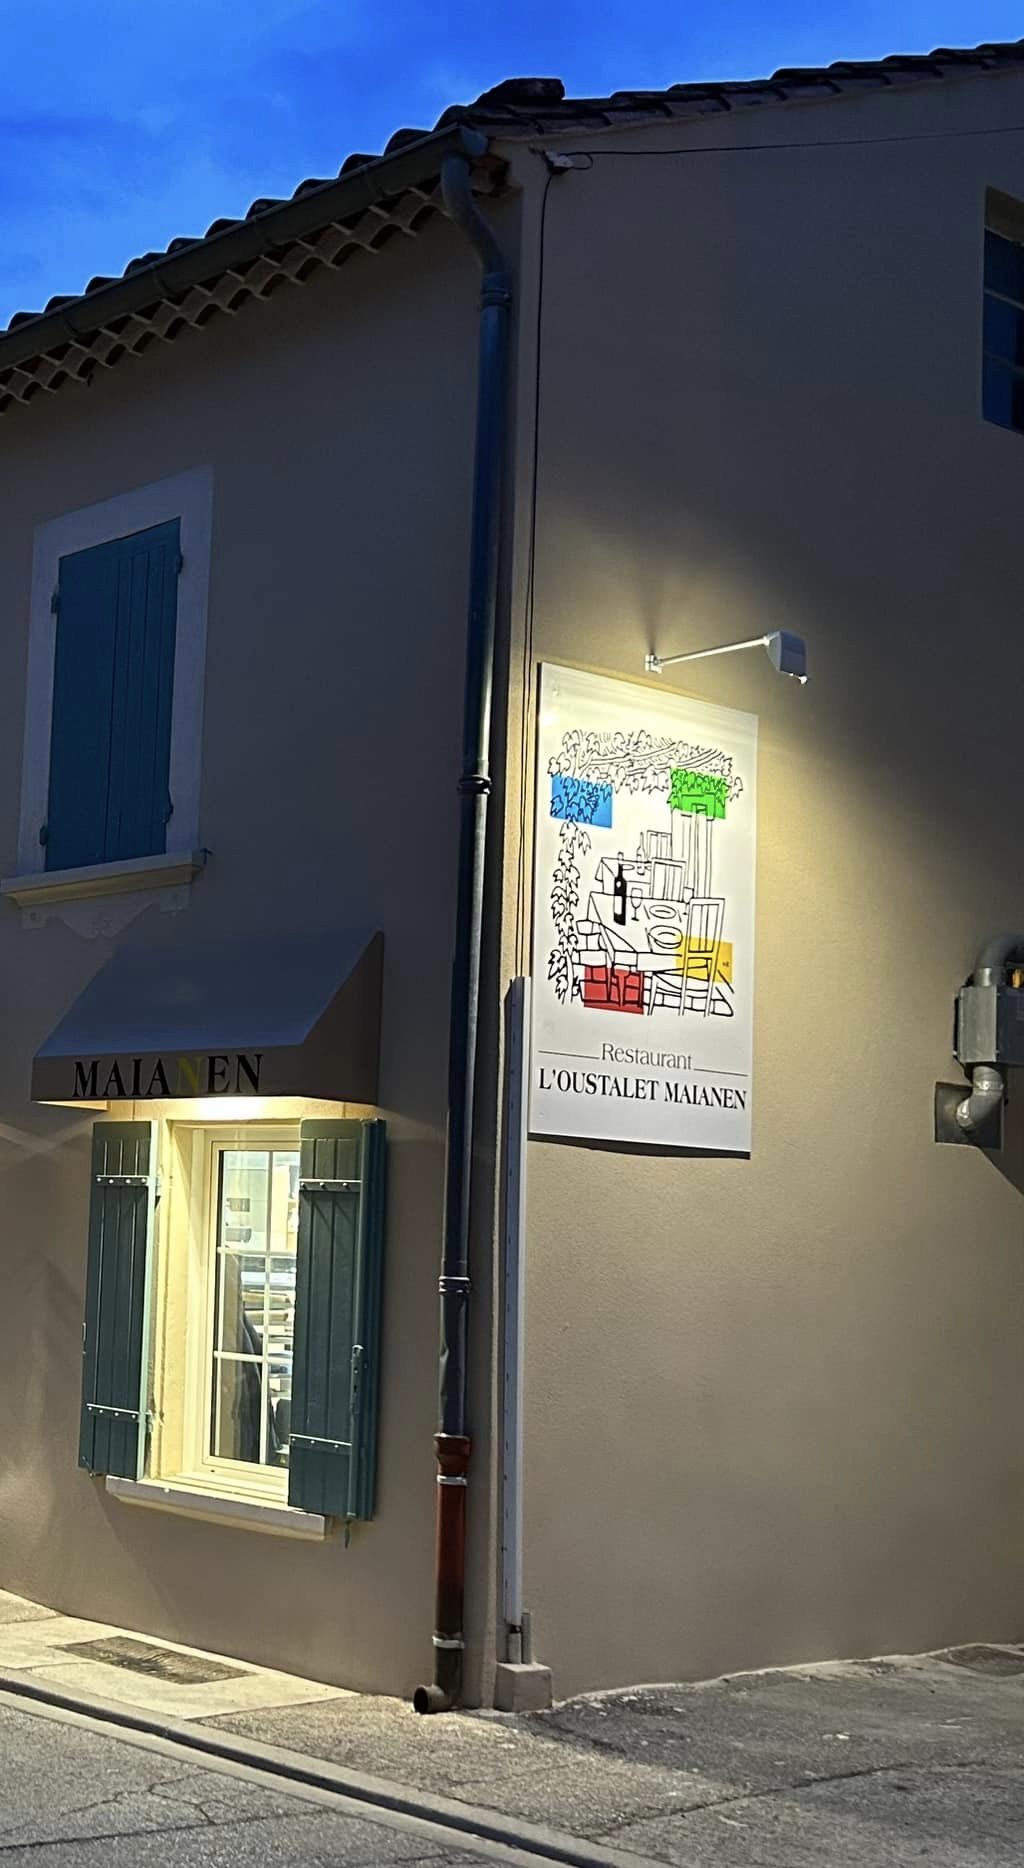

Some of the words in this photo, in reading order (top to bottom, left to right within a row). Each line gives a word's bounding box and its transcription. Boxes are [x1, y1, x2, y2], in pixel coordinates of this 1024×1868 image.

[72, 1054, 264, 1097] MAIANEN
[601, 1043, 693, 1070] Restaurant
[538, 1068, 659, 1101] L'OUSTALET
[664, 1081, 747, 1110] MAIANEN
